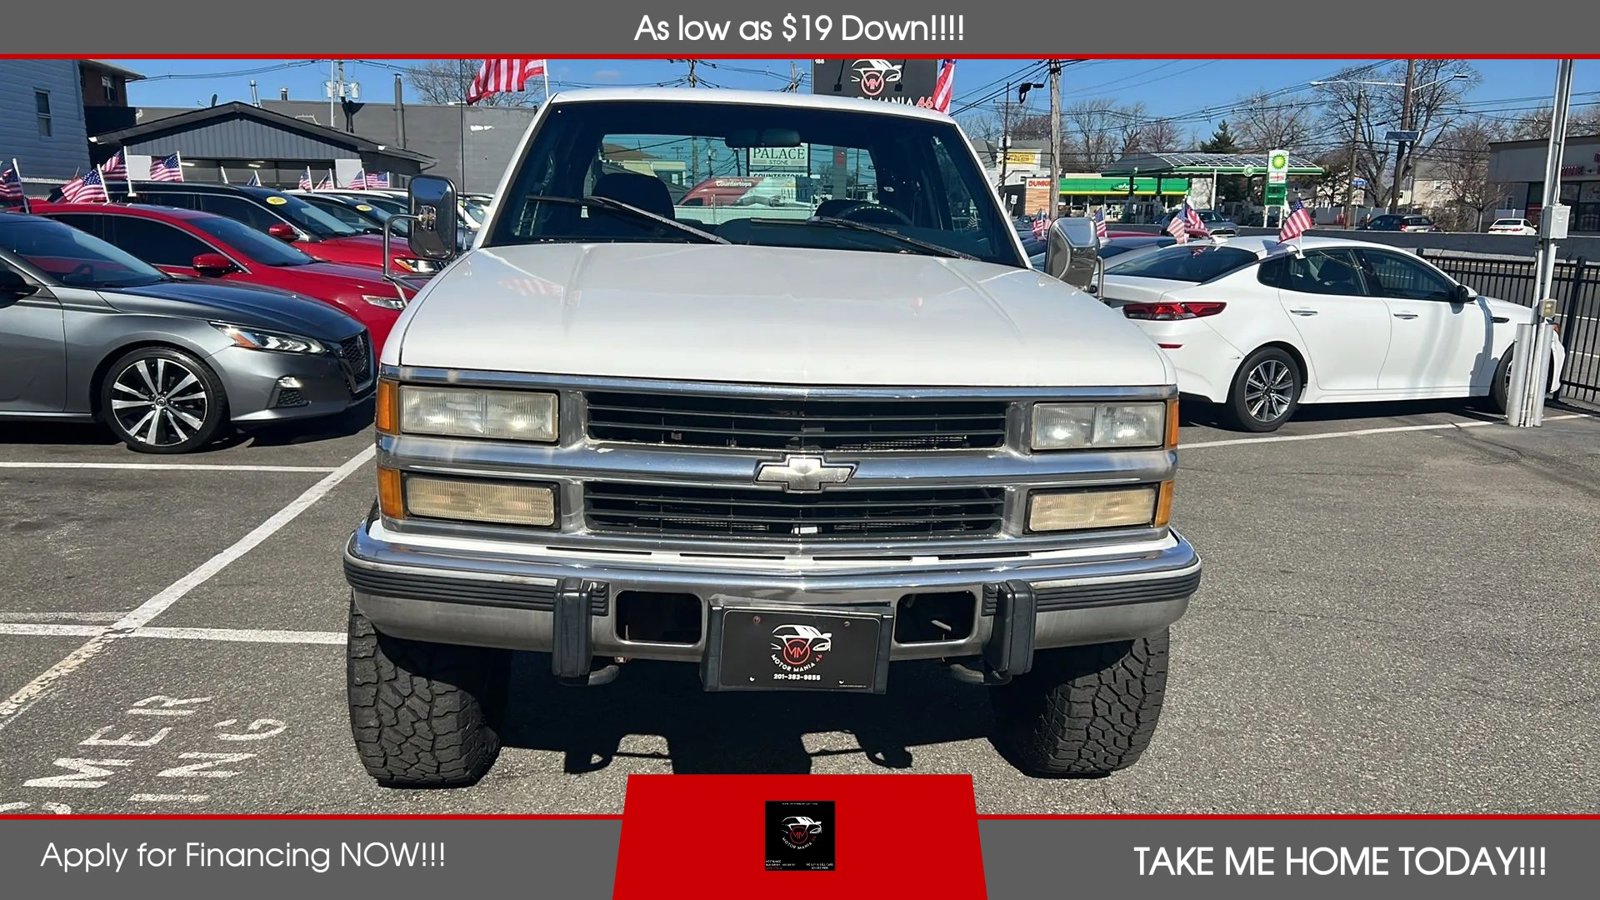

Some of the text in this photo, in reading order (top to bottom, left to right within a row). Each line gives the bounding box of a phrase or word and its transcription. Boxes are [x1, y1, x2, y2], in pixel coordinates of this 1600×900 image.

[753, 147, 805, 159] PALACE
[771, 653, 792, 672] MOTOR
[793, 662, 816, 672] MANIA
